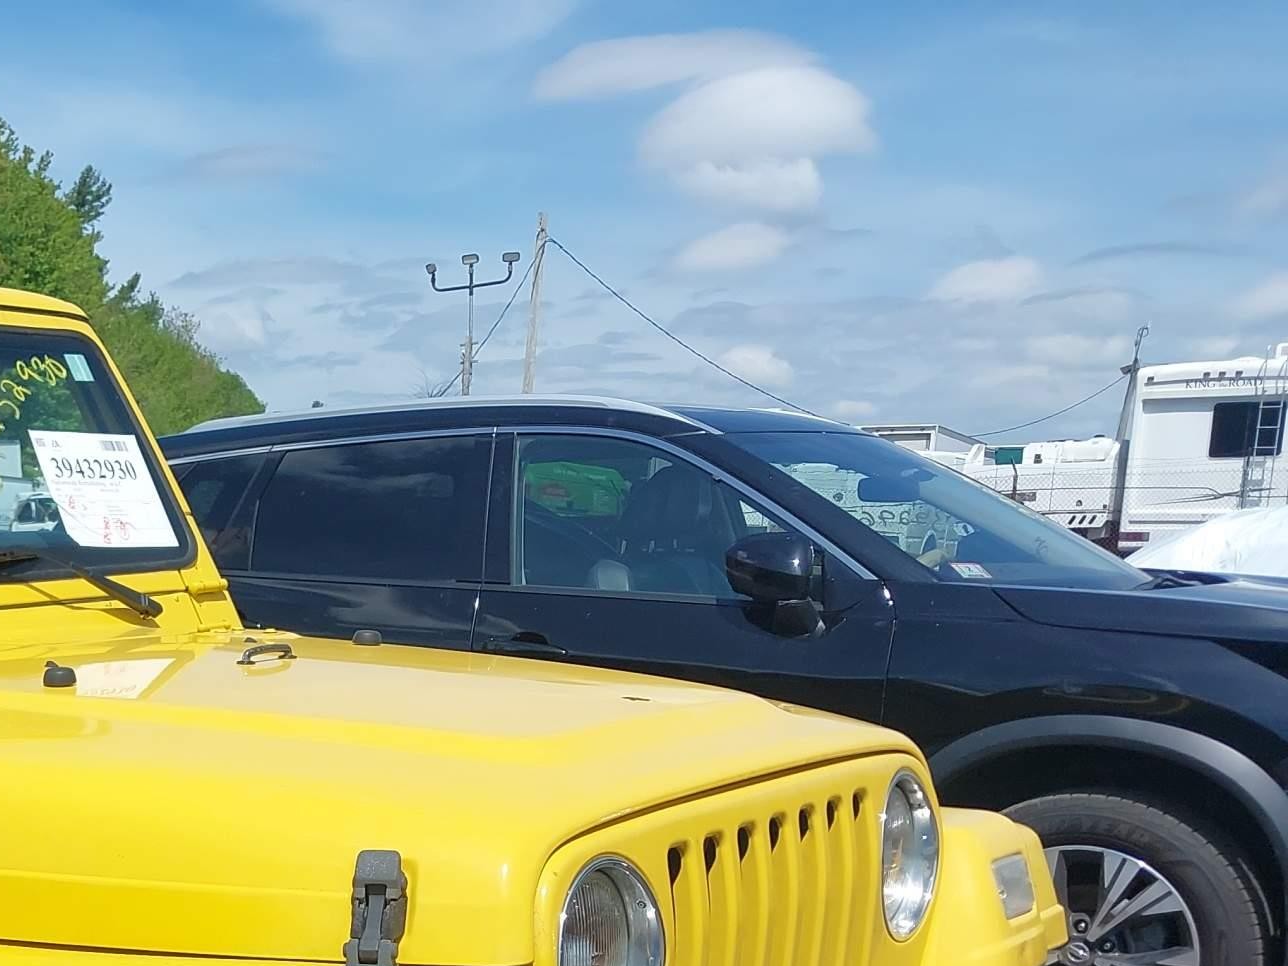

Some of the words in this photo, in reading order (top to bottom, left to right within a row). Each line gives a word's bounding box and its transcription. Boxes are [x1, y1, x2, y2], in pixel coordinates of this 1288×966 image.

[1185, 379, 1216, 389] KING
[1228, 377, 1263, 389] ROAD
[50, 457, 137, 481] 39432930
